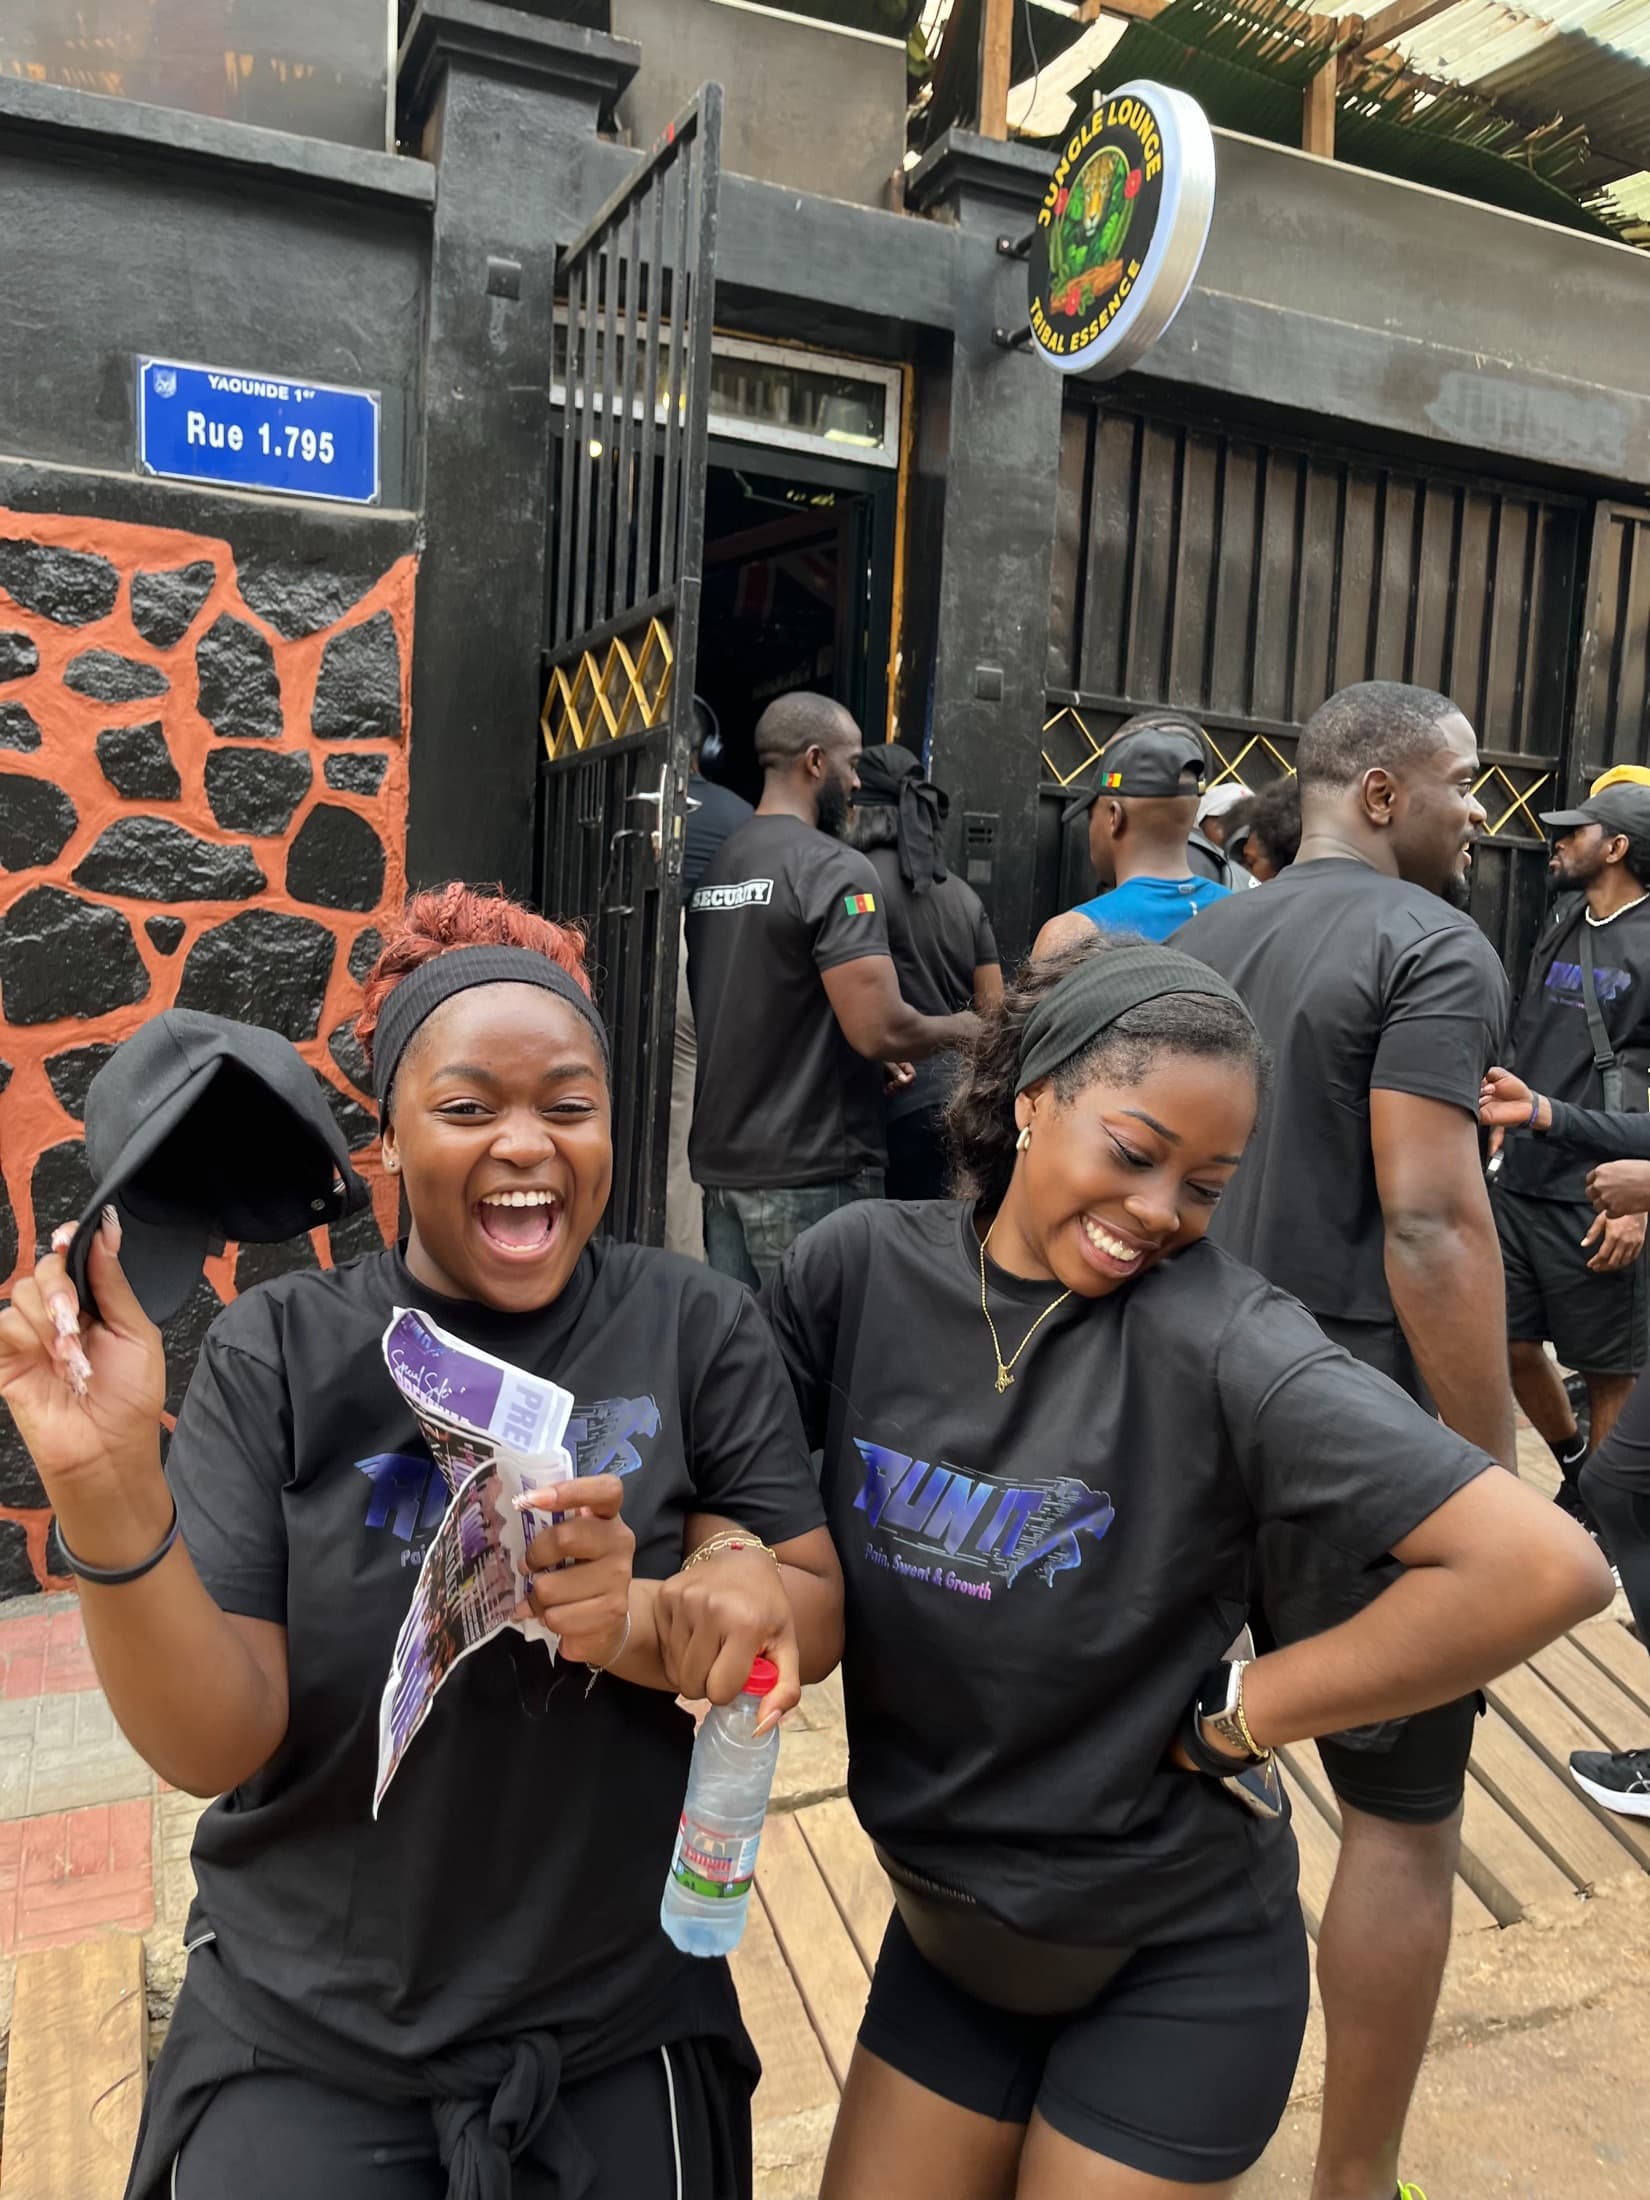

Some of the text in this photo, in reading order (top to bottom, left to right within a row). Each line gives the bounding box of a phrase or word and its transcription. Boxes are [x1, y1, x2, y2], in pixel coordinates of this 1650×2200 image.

[1038, 98, 1162, 227] JUNGLE LOUNGE
[1030, 259, 1140, 353] TRIBAL ESSENCE
[208, 374, 289, 400] YAOUNDE
[187, 410, 335, 464] Rue 1.795
[853, 1436, 1048, 1558] RUN IT
[892, 1553, 931, 1582] Sweat
[932, 1567, 943, 1587] &
[945, 1570, 992, 1601] Growth
